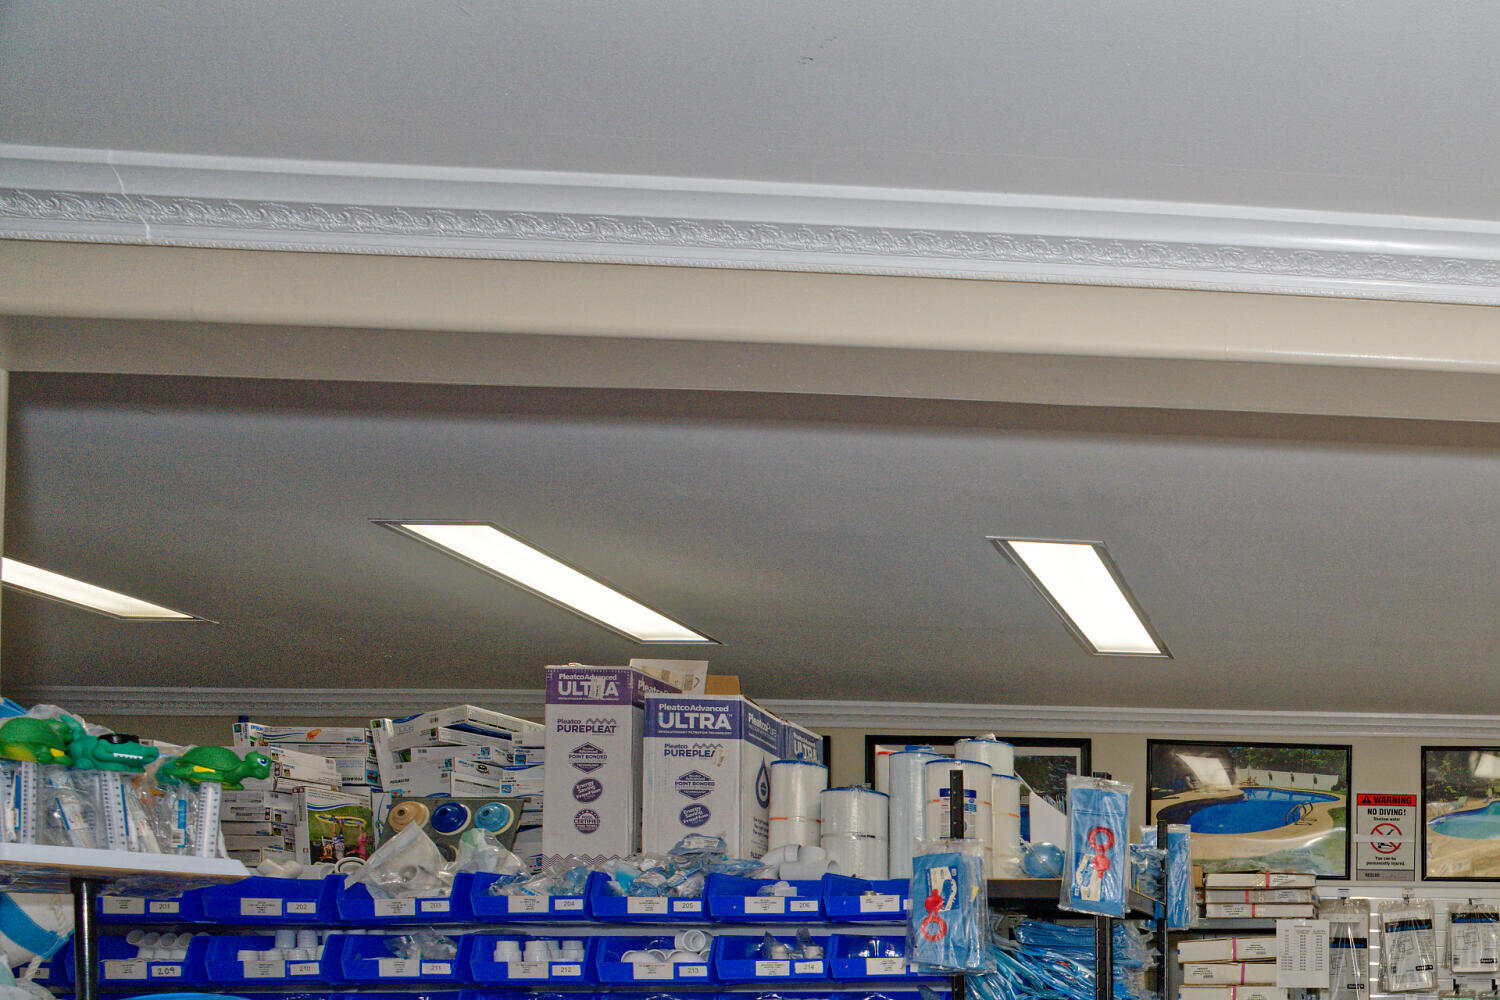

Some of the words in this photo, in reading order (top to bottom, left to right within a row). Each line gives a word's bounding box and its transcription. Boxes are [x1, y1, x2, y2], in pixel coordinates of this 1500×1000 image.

[658, 704, 729, 712] PleatcoAdvanced
[658, 713, 732, 730] ULTRA
[556, 725, 616, 734] PUREPLEAT
[1374, 796, 1412, 804] WARNING
[1368, 808, 1377, 816] NO
[1378, 808, 1406, 816] DIVING!
[158, 966, 176, 976] 209
